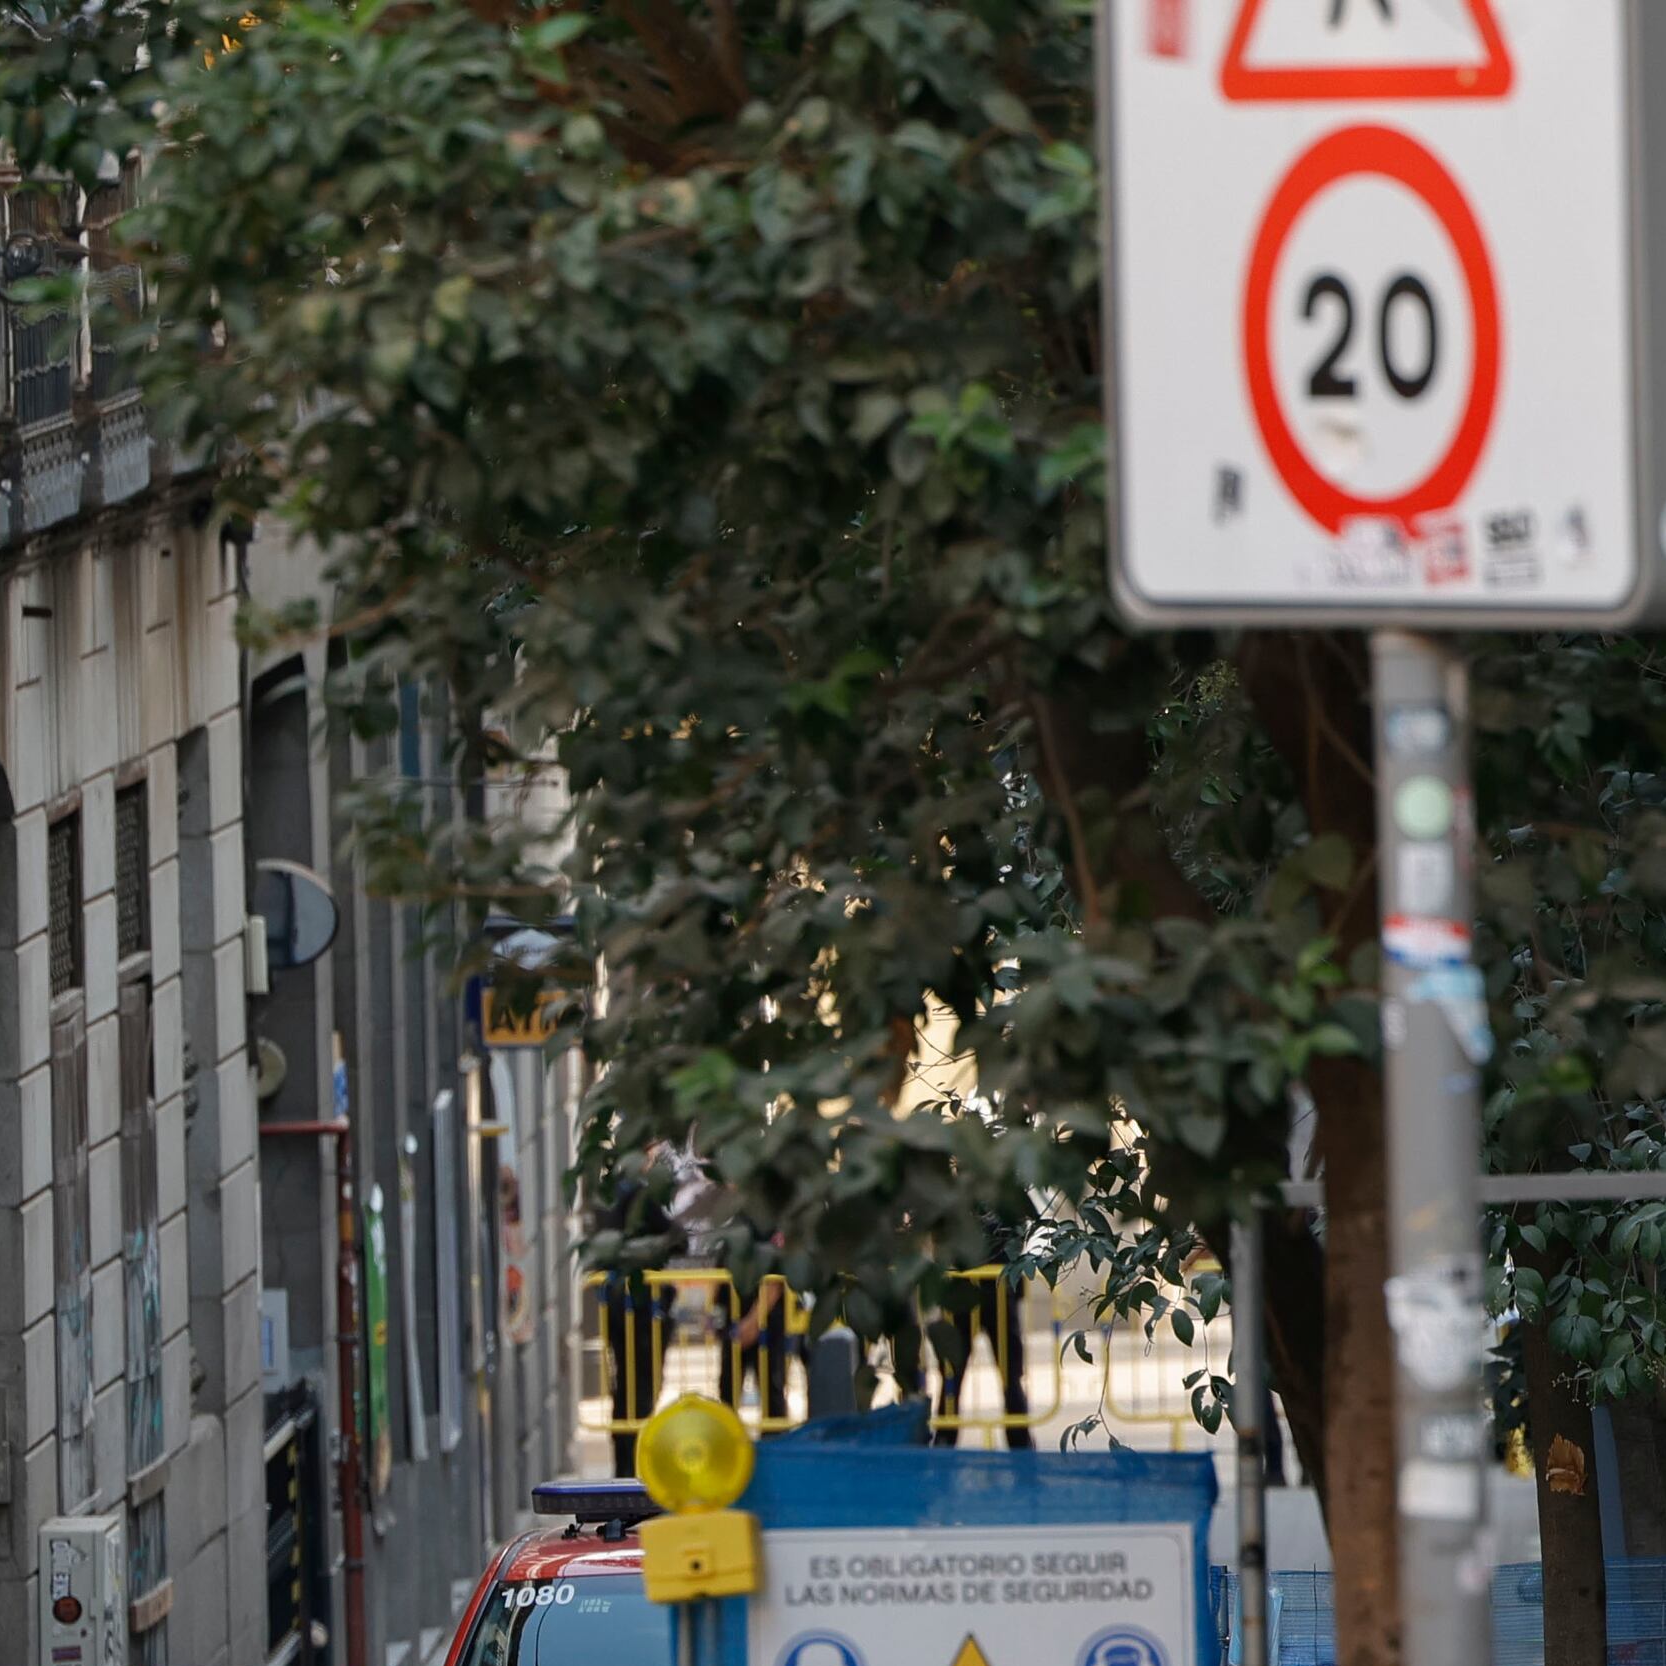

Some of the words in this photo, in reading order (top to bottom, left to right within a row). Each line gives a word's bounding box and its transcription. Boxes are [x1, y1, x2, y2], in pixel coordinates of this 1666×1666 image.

[1302, 273, 1440, 399] 20
[810, 1554, 841, 1579] ES
[847, 1551, 1025, 1579] OBLIGATORIO
[1032, 1550, 1127, 1576] SEGUIR
[501, 1583, 575, 1609] 1080
[785, 1581, 834, 1607] LAS
[840, 1581, 955, 1606] NORMAS
[962, 1579, 997, 1605] DE
[1003, 1577, 1155, 1605] SEGURIDAD
